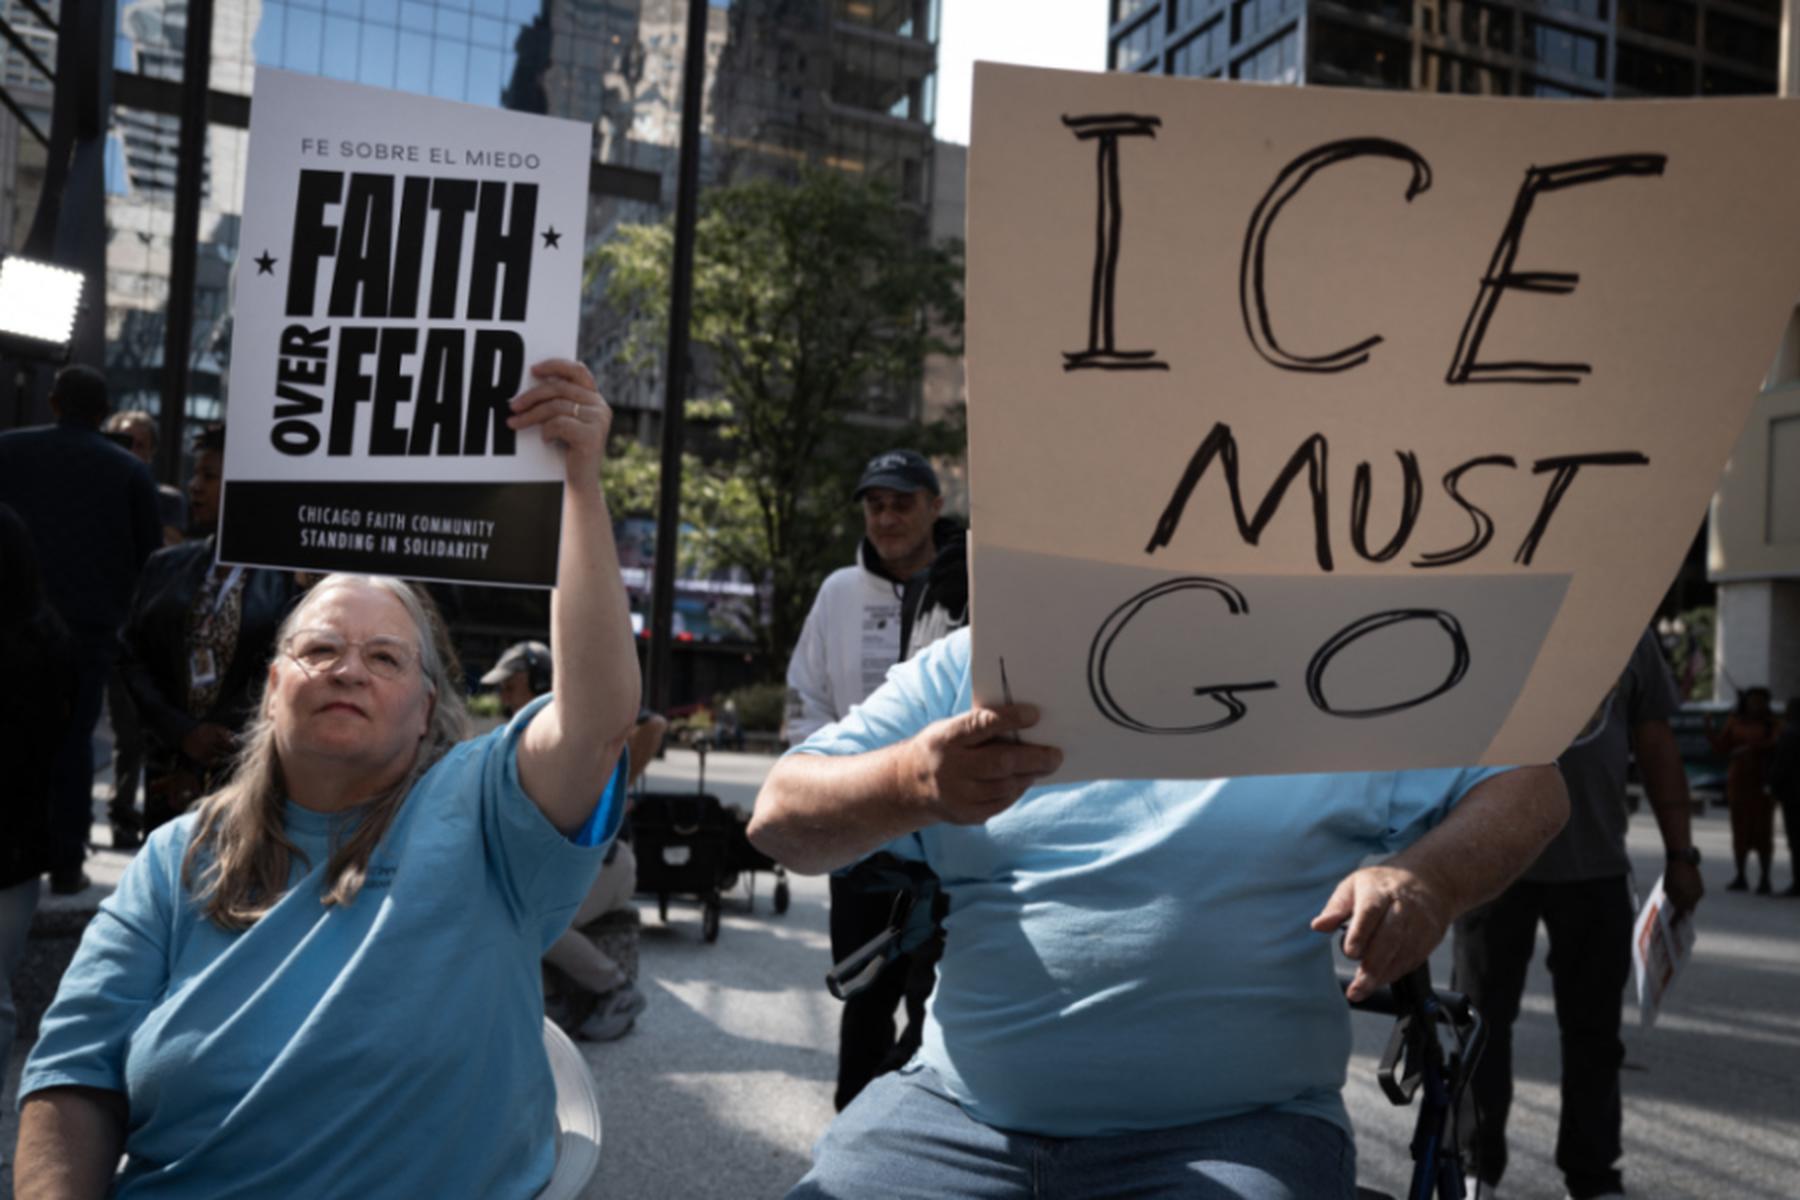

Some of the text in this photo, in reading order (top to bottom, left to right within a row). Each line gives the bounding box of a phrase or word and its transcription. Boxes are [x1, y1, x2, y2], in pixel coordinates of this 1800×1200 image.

[300, 137, 541, 170] FE SOBRE EL MIEDO
[285, 168, 539, 322] FAITH
[1060, 111, 1669, 386] ICE
[270, 323, 331, 457] OVER
[327, 326, 525, 457] FEAR
[298, 505, 495, 537] CHICAGO FAITH COMMUNITY
[300, 529, 490, 559] STANDING IN SOLIDARITY
[1145, 422, 1651, 572] MUST
[1086, 576, 1471, 735] GO
